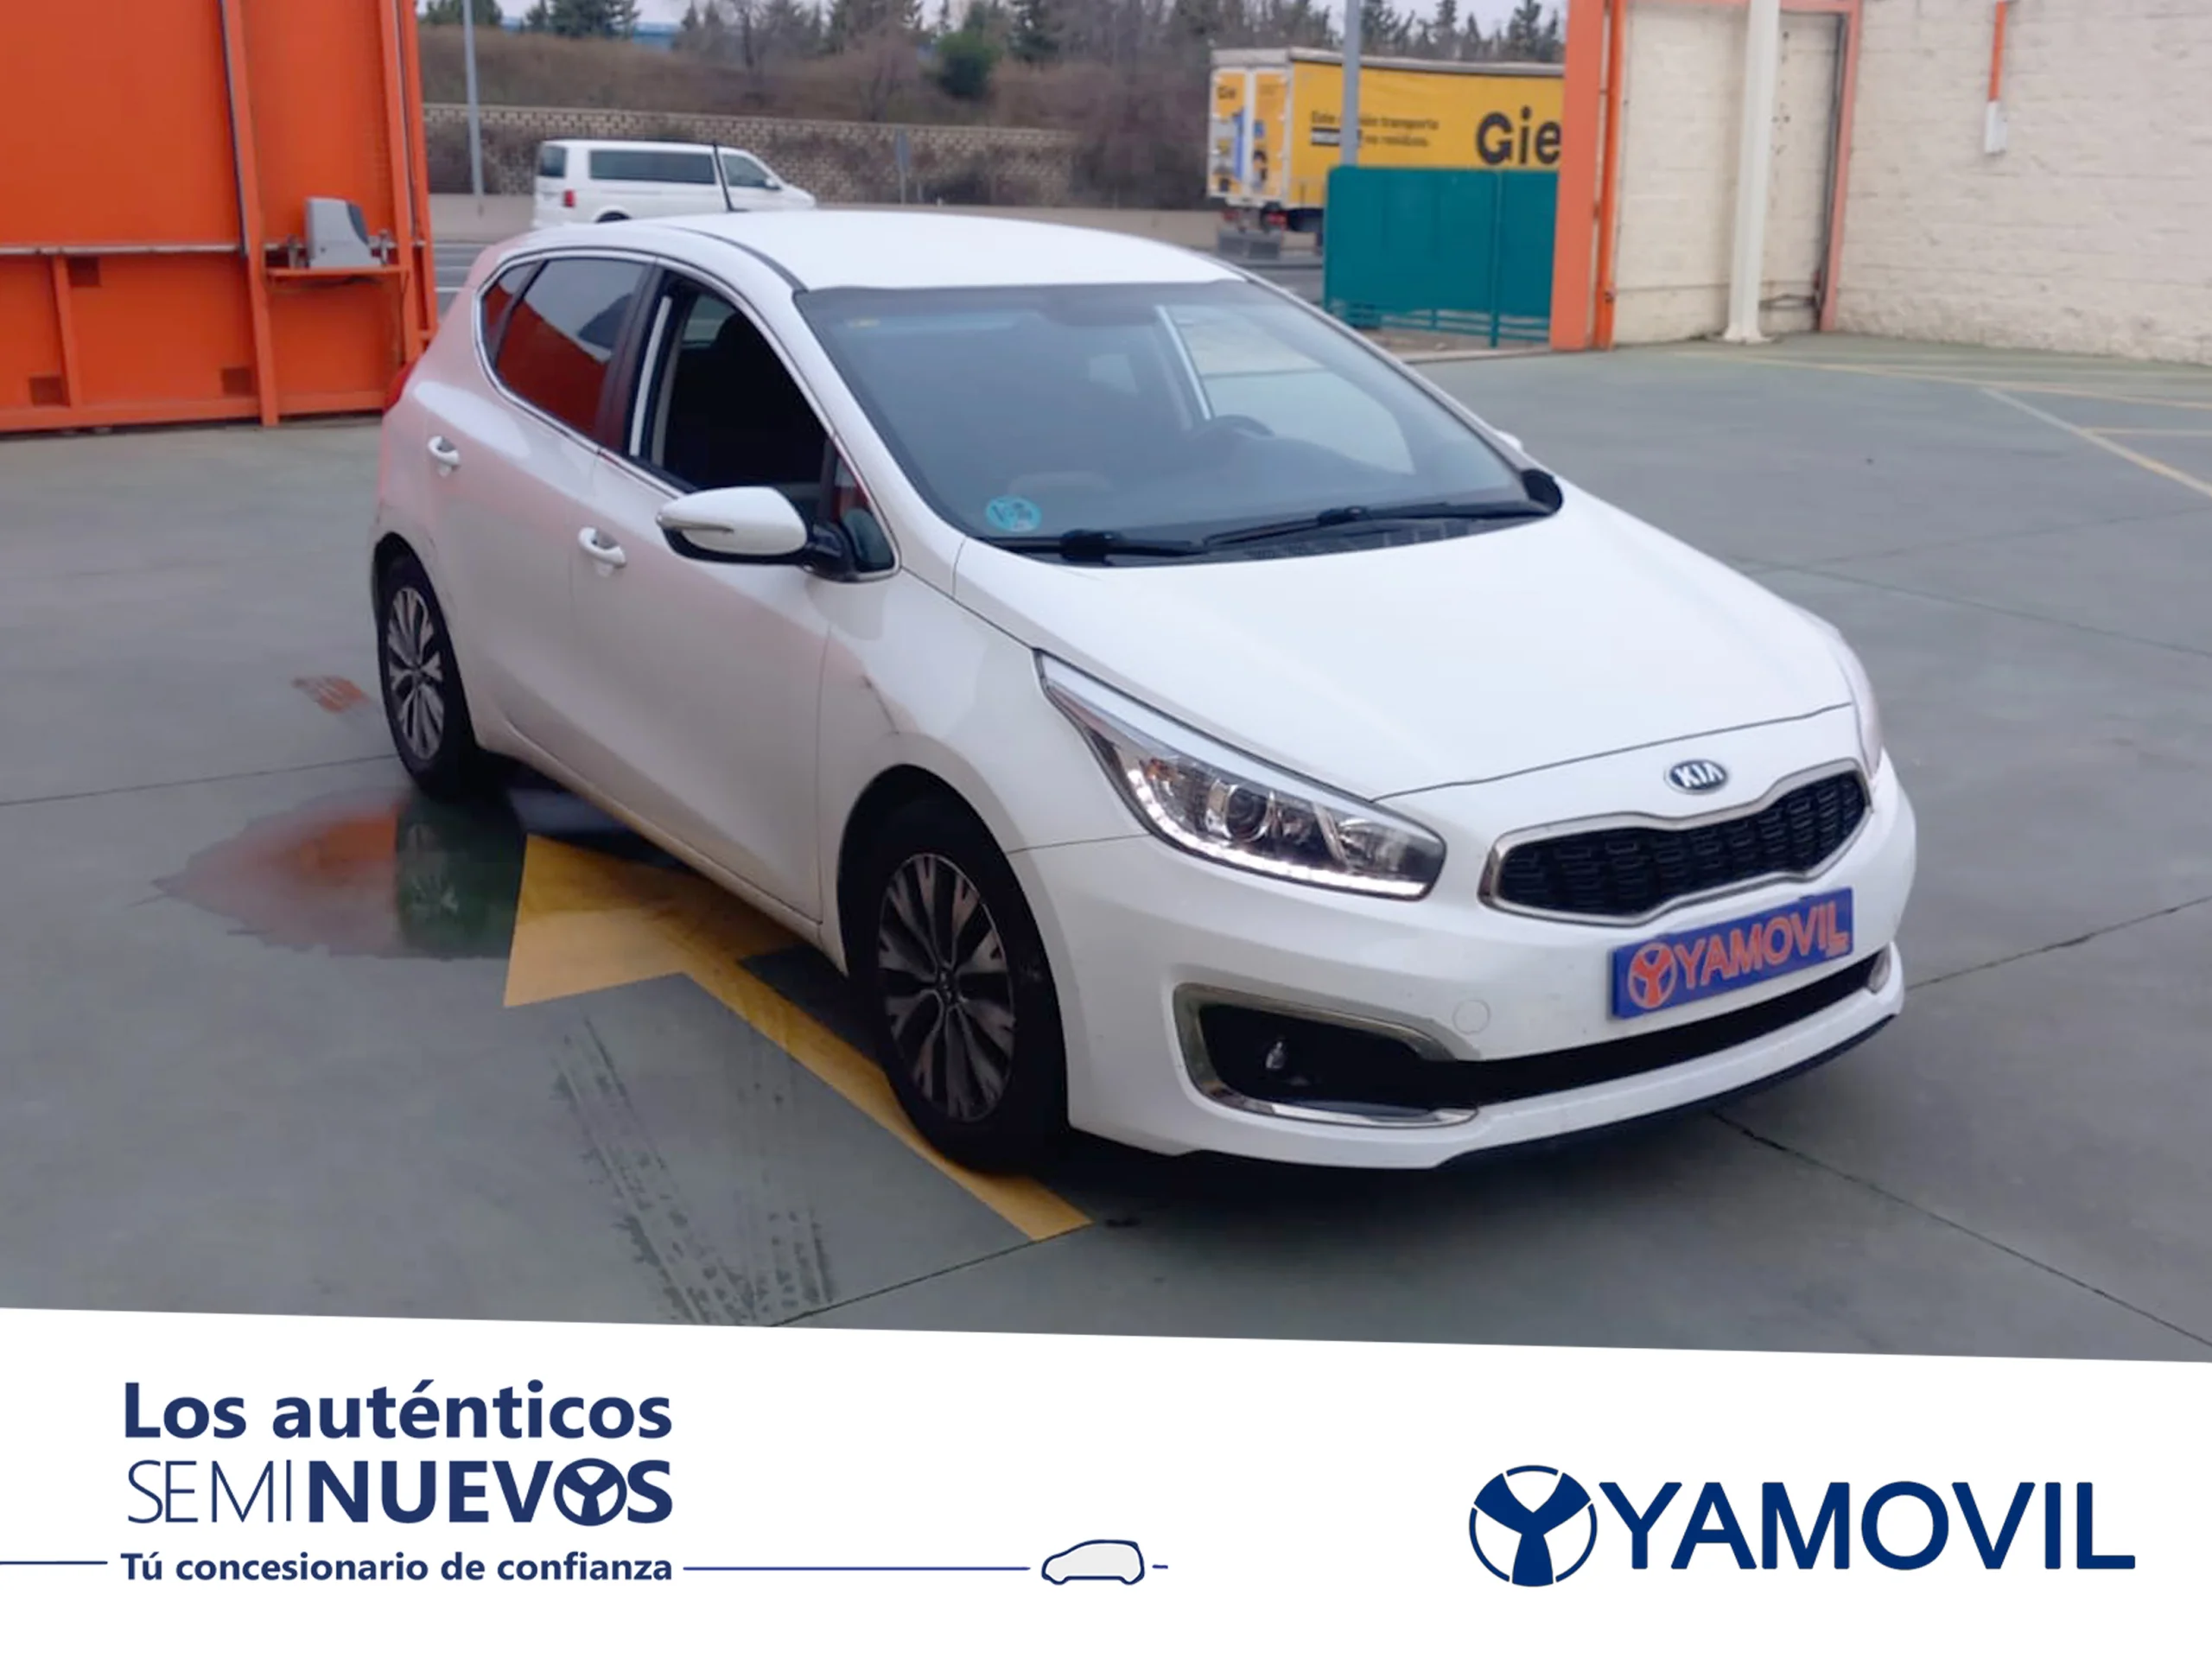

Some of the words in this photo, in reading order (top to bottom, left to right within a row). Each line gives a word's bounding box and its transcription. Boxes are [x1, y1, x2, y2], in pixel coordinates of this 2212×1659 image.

[1476, 105, 1561, 166] Gie
[1675, 762, 1723, 787] KIA
[1673, 901, 1849, 989] YAMOVIL
